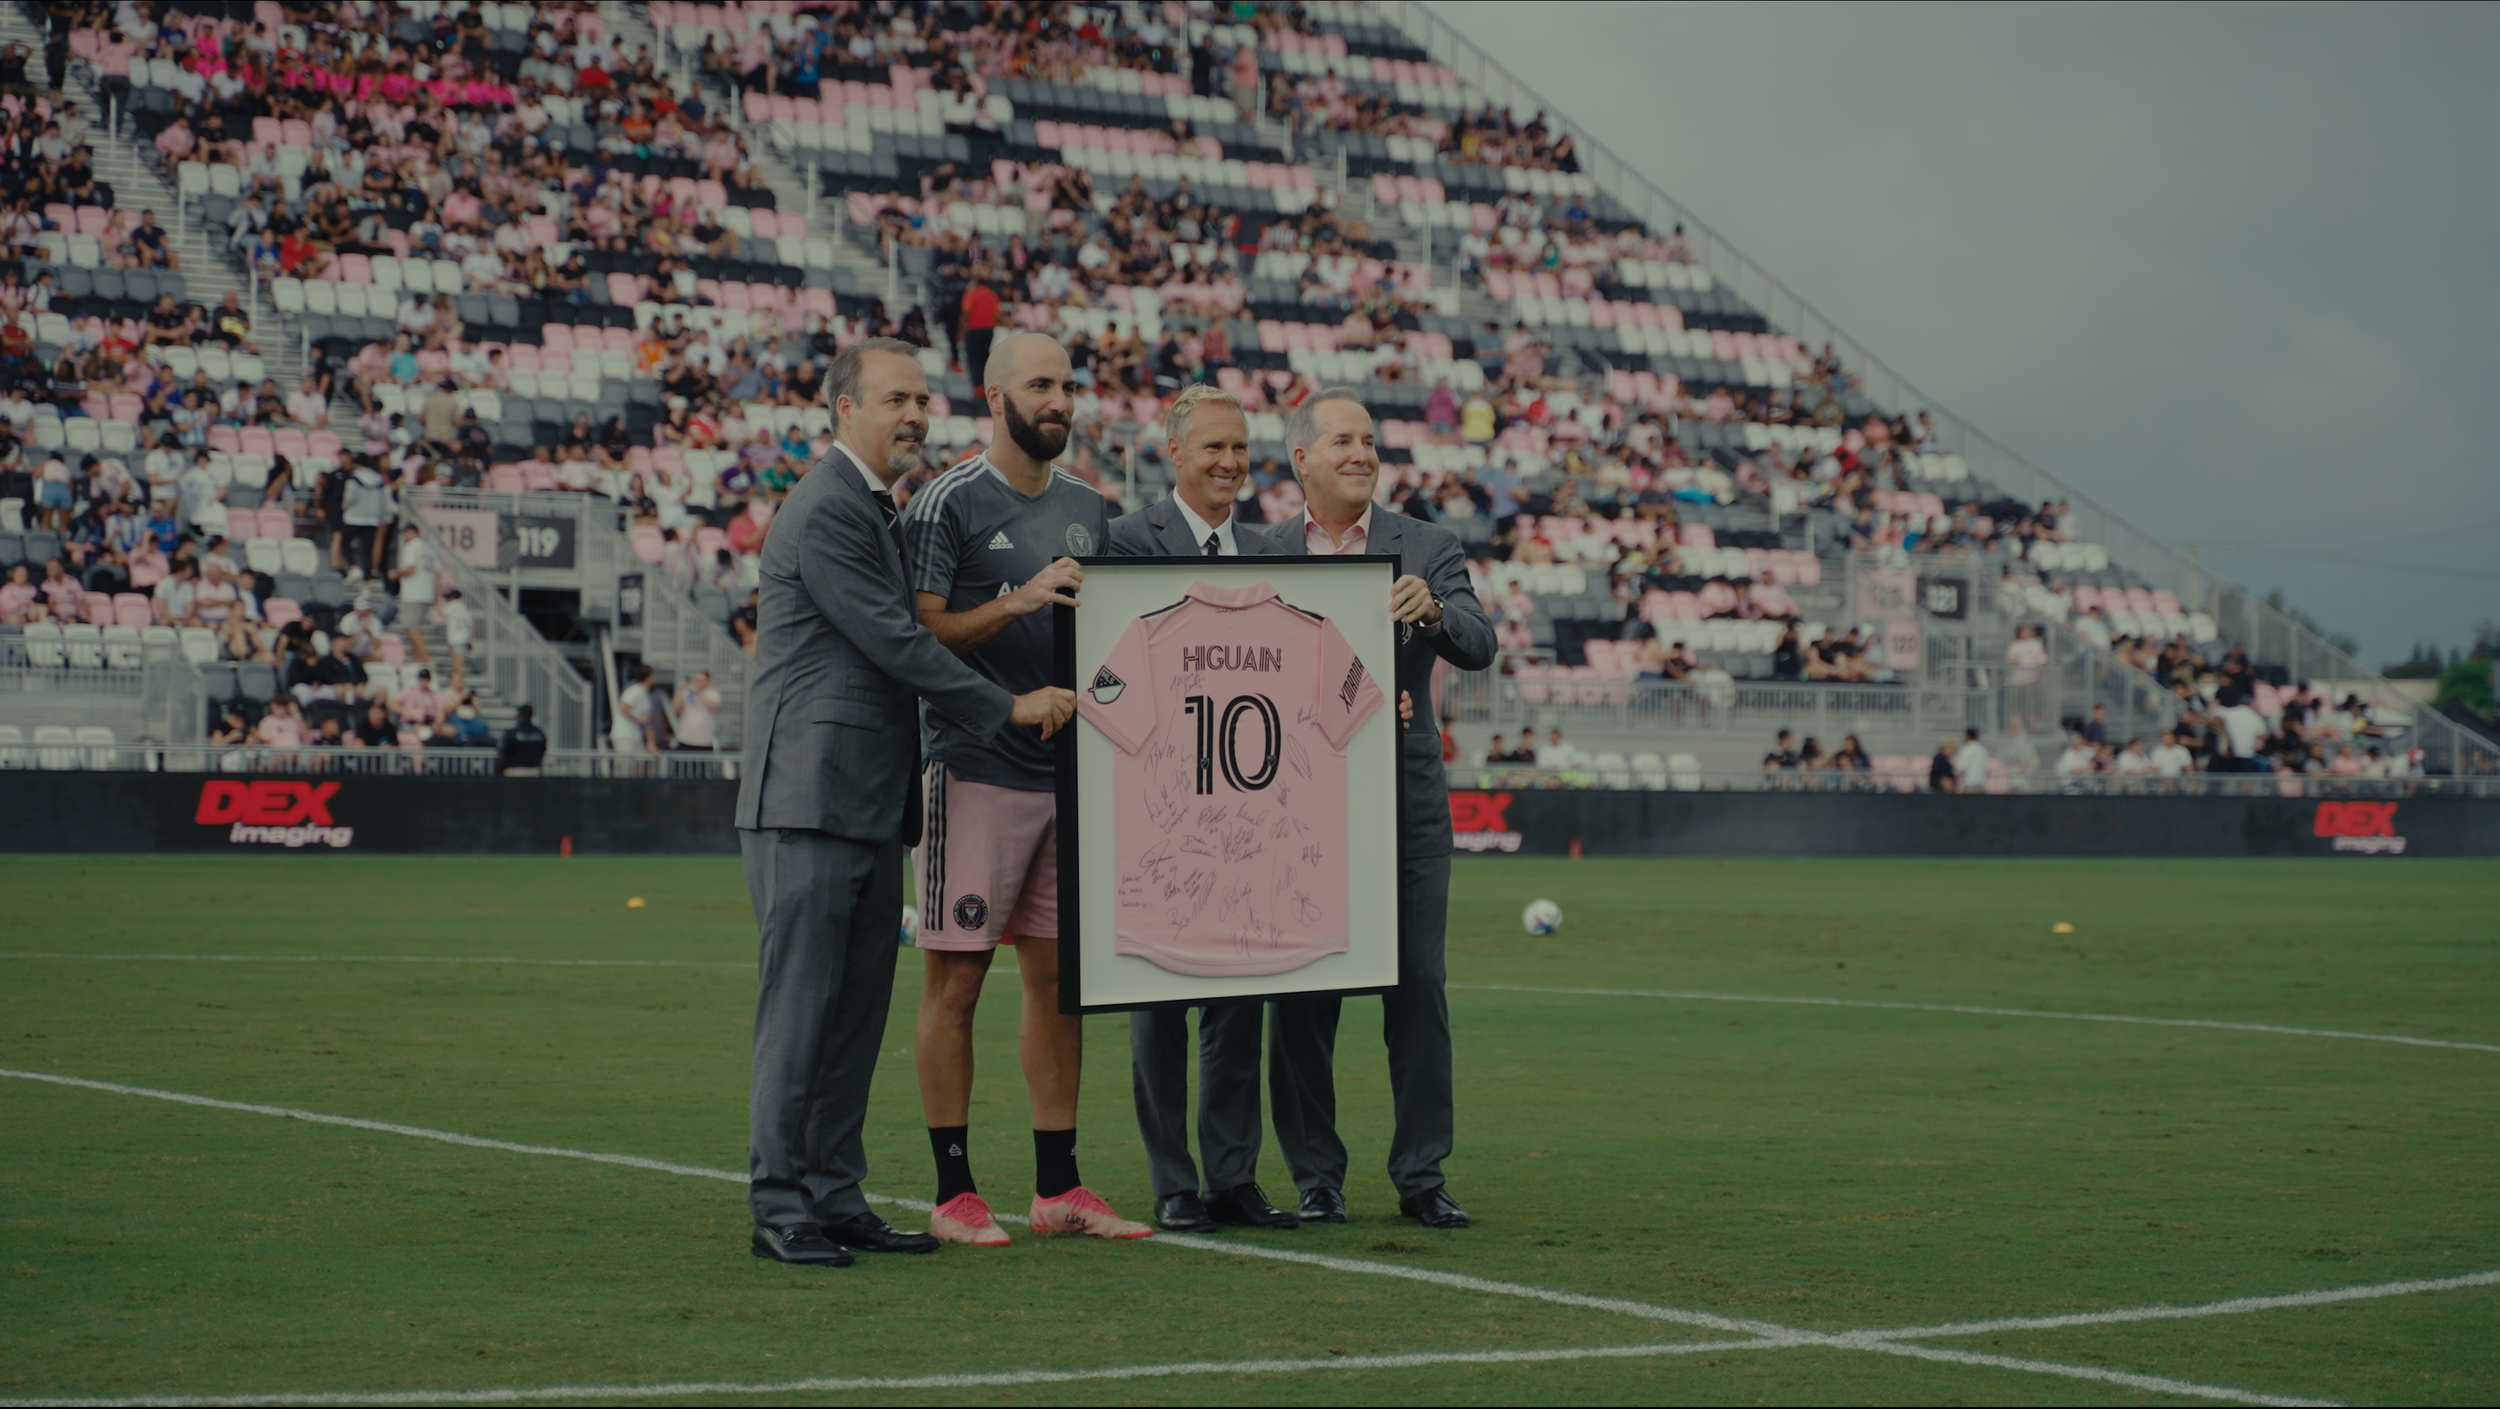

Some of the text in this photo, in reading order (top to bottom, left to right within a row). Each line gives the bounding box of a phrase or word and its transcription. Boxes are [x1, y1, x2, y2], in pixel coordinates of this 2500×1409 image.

[516, 527, 560, 557] 119
[1183, 645, 1282, 672] HIGUAIN
[1339, 656, 1365, 714] XMANNA
[1184, 693, 1281, 795] 10
[194, 780, 342, 826] DEX
[1449, 791, 1514, 833] EX
[2313, 801, 2398, 836] DEX
[229, 822, 354, 848] imaging
[2333, 833, 2407, 854] imaging
